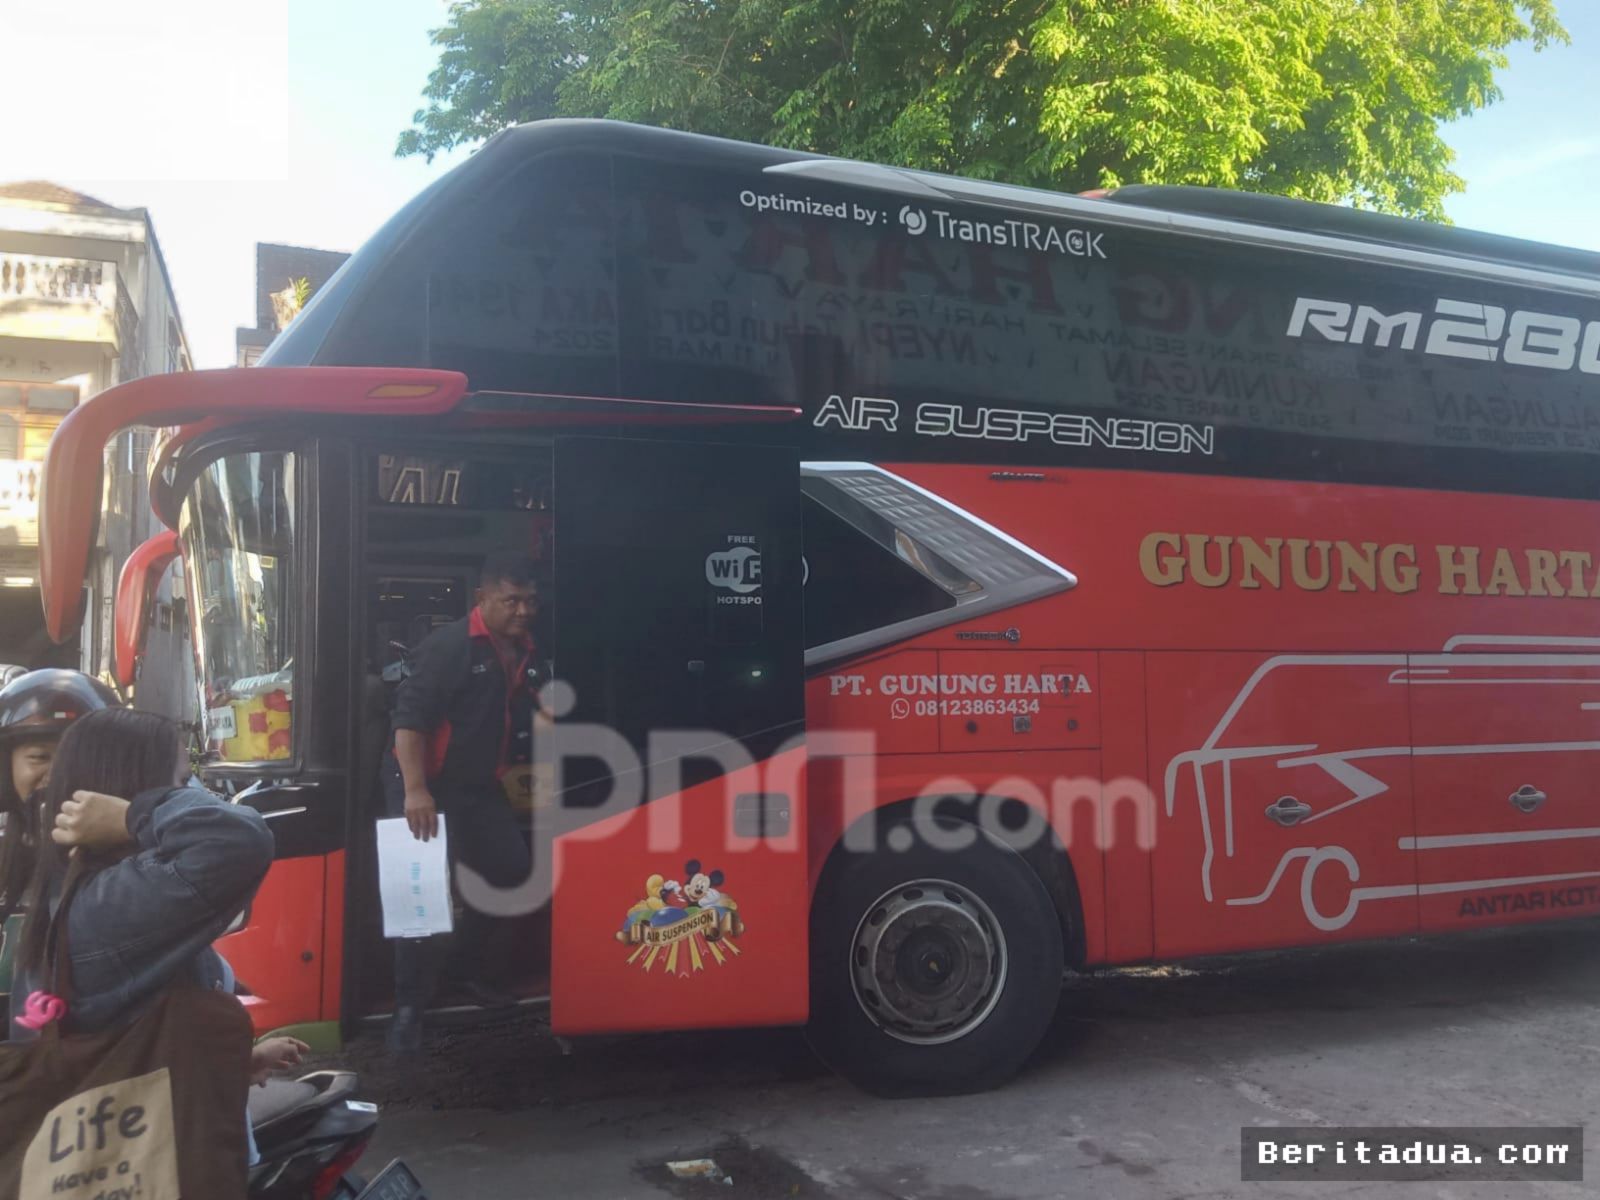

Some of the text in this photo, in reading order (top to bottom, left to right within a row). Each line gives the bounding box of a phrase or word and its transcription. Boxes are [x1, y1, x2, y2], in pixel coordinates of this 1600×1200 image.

[740, 190, 848, 219] Optimized
[932, 210, 1107, 259] TransTRACK
[1286, 297, 1600, 374] RM28
[813, 395, 1214, 455] AIR SUSPENSION
[727, 535, 756, 543] FREE
[711, 559, 761, 579] WiF
[1139, 531, 1420, 595] GUNUNG
[717, 596, 762, 605] HOTSPO
[829, 674, 1092, 696] PT. GUNUNG HARTA
[915, 699, 1040, 716] 08123863434
[1457, 885, 1600, 918] ANTAR KOT
[646, 911, 714, 942] AIR SUSPENSION
[48, 1095, 148, 1163] Life
[52, 1160, 130, 1194] Have a
